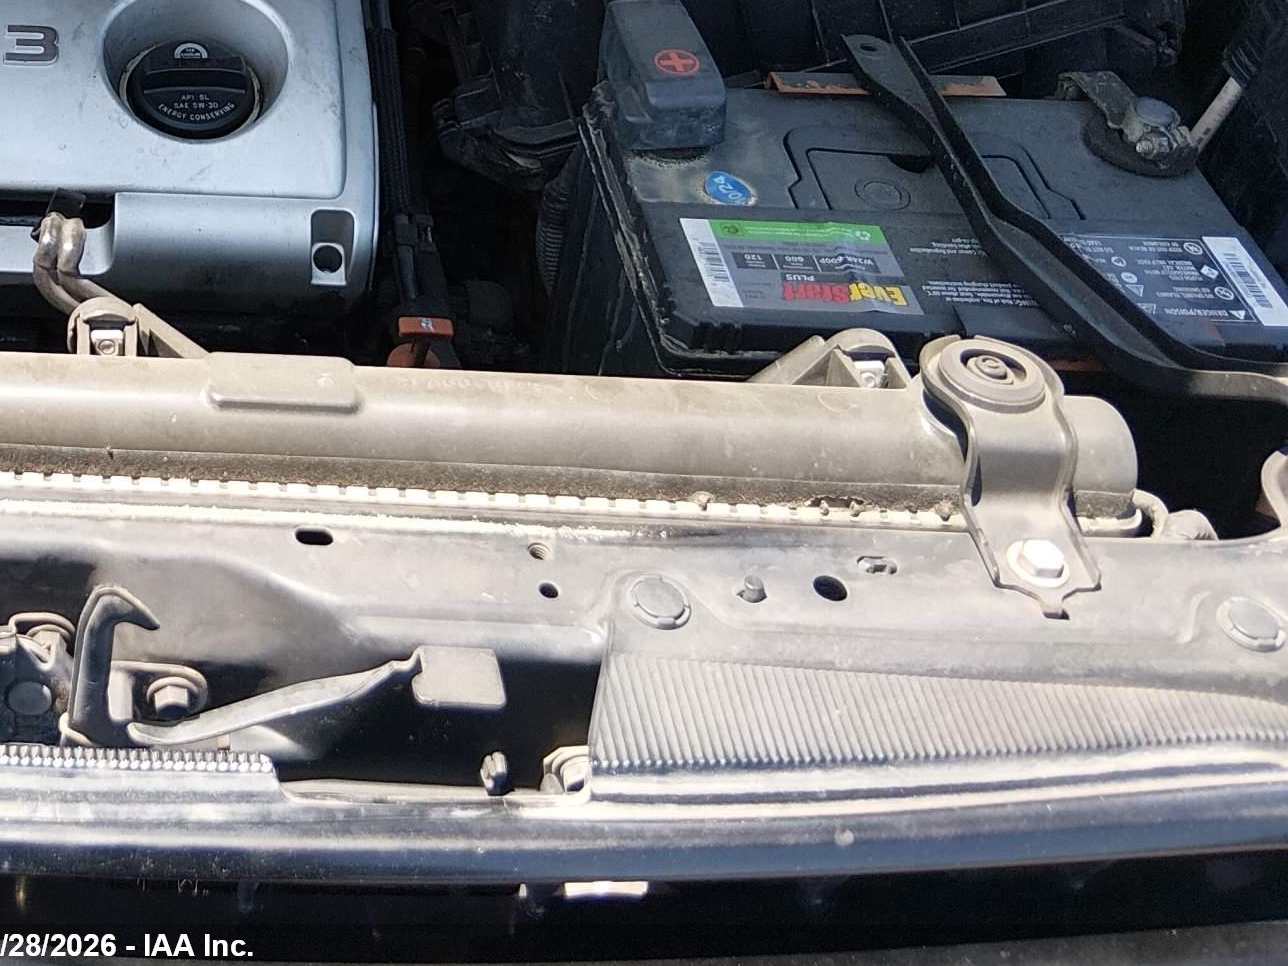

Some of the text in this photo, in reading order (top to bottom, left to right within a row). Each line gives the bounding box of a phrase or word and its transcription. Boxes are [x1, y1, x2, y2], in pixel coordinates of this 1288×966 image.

[158, 101, 235, 121] ENERGY CONSERVING
[743, 253, 762, 261] 120
[784, 255, 805, 263] 600
[785, 273, 815, 282] PLUS
